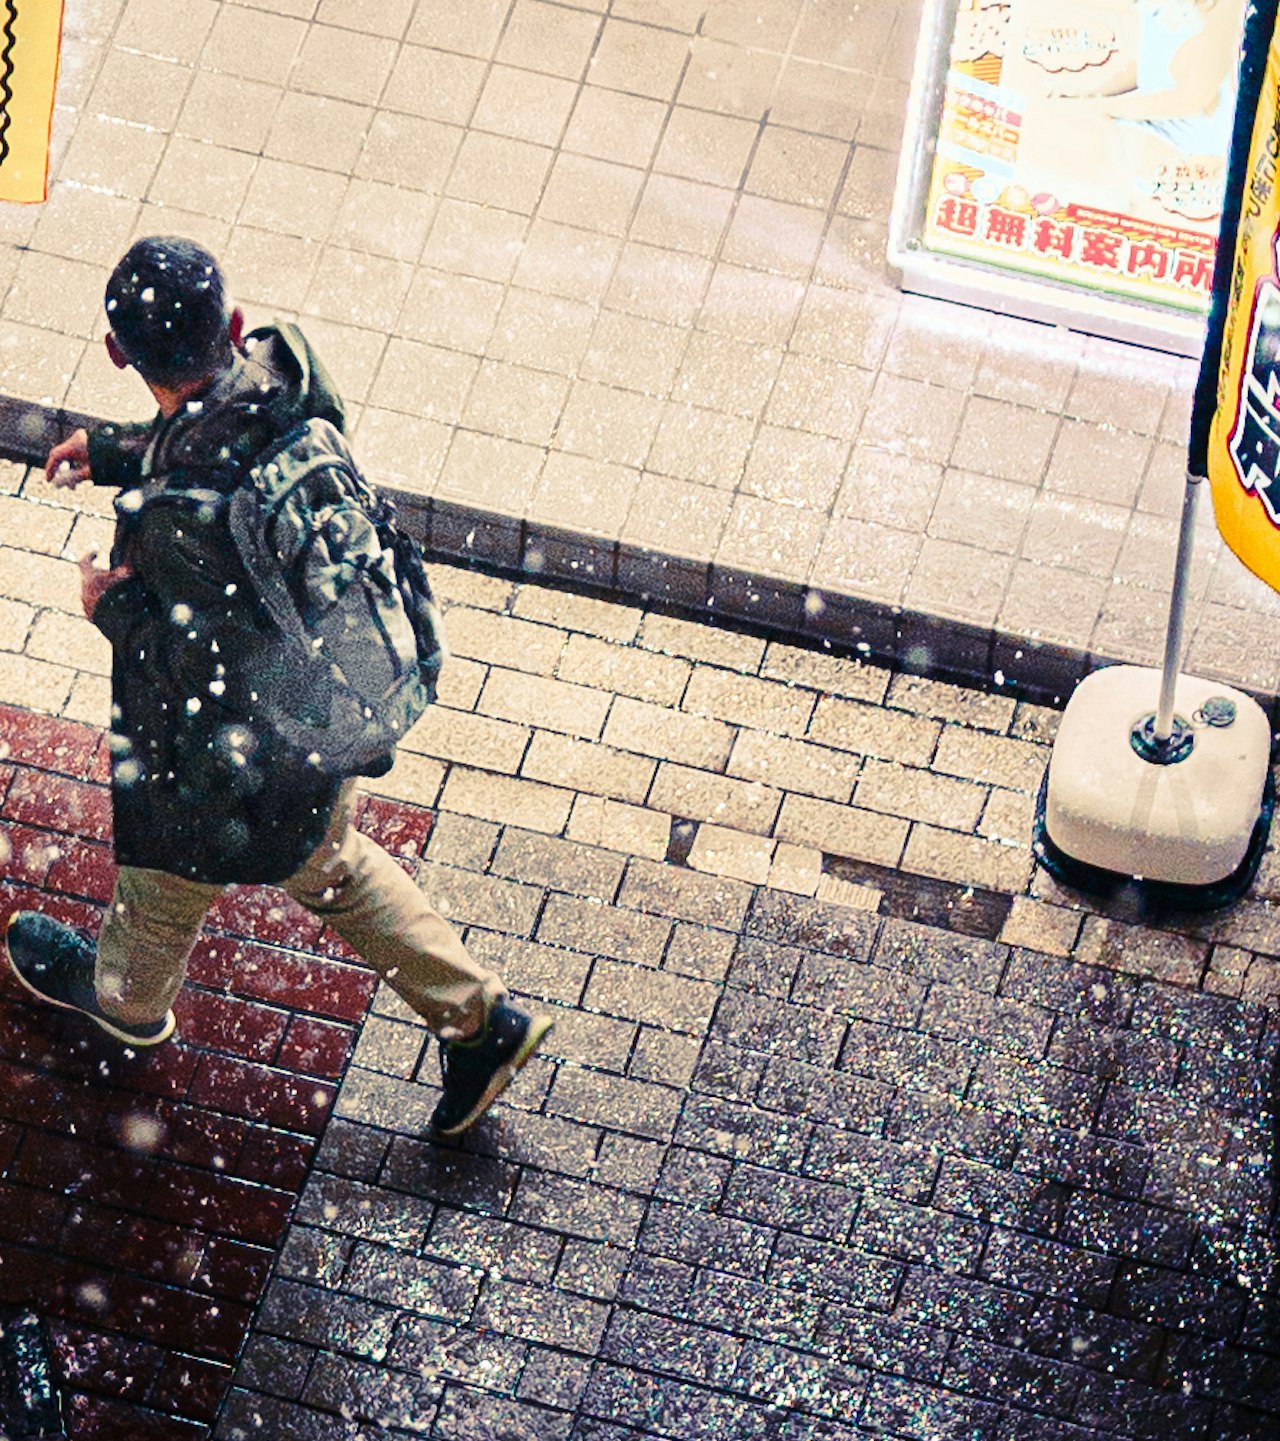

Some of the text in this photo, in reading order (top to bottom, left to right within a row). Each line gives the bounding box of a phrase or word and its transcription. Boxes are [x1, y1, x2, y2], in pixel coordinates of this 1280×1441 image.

[936, 198, 1216, 293] 超無料案内所
